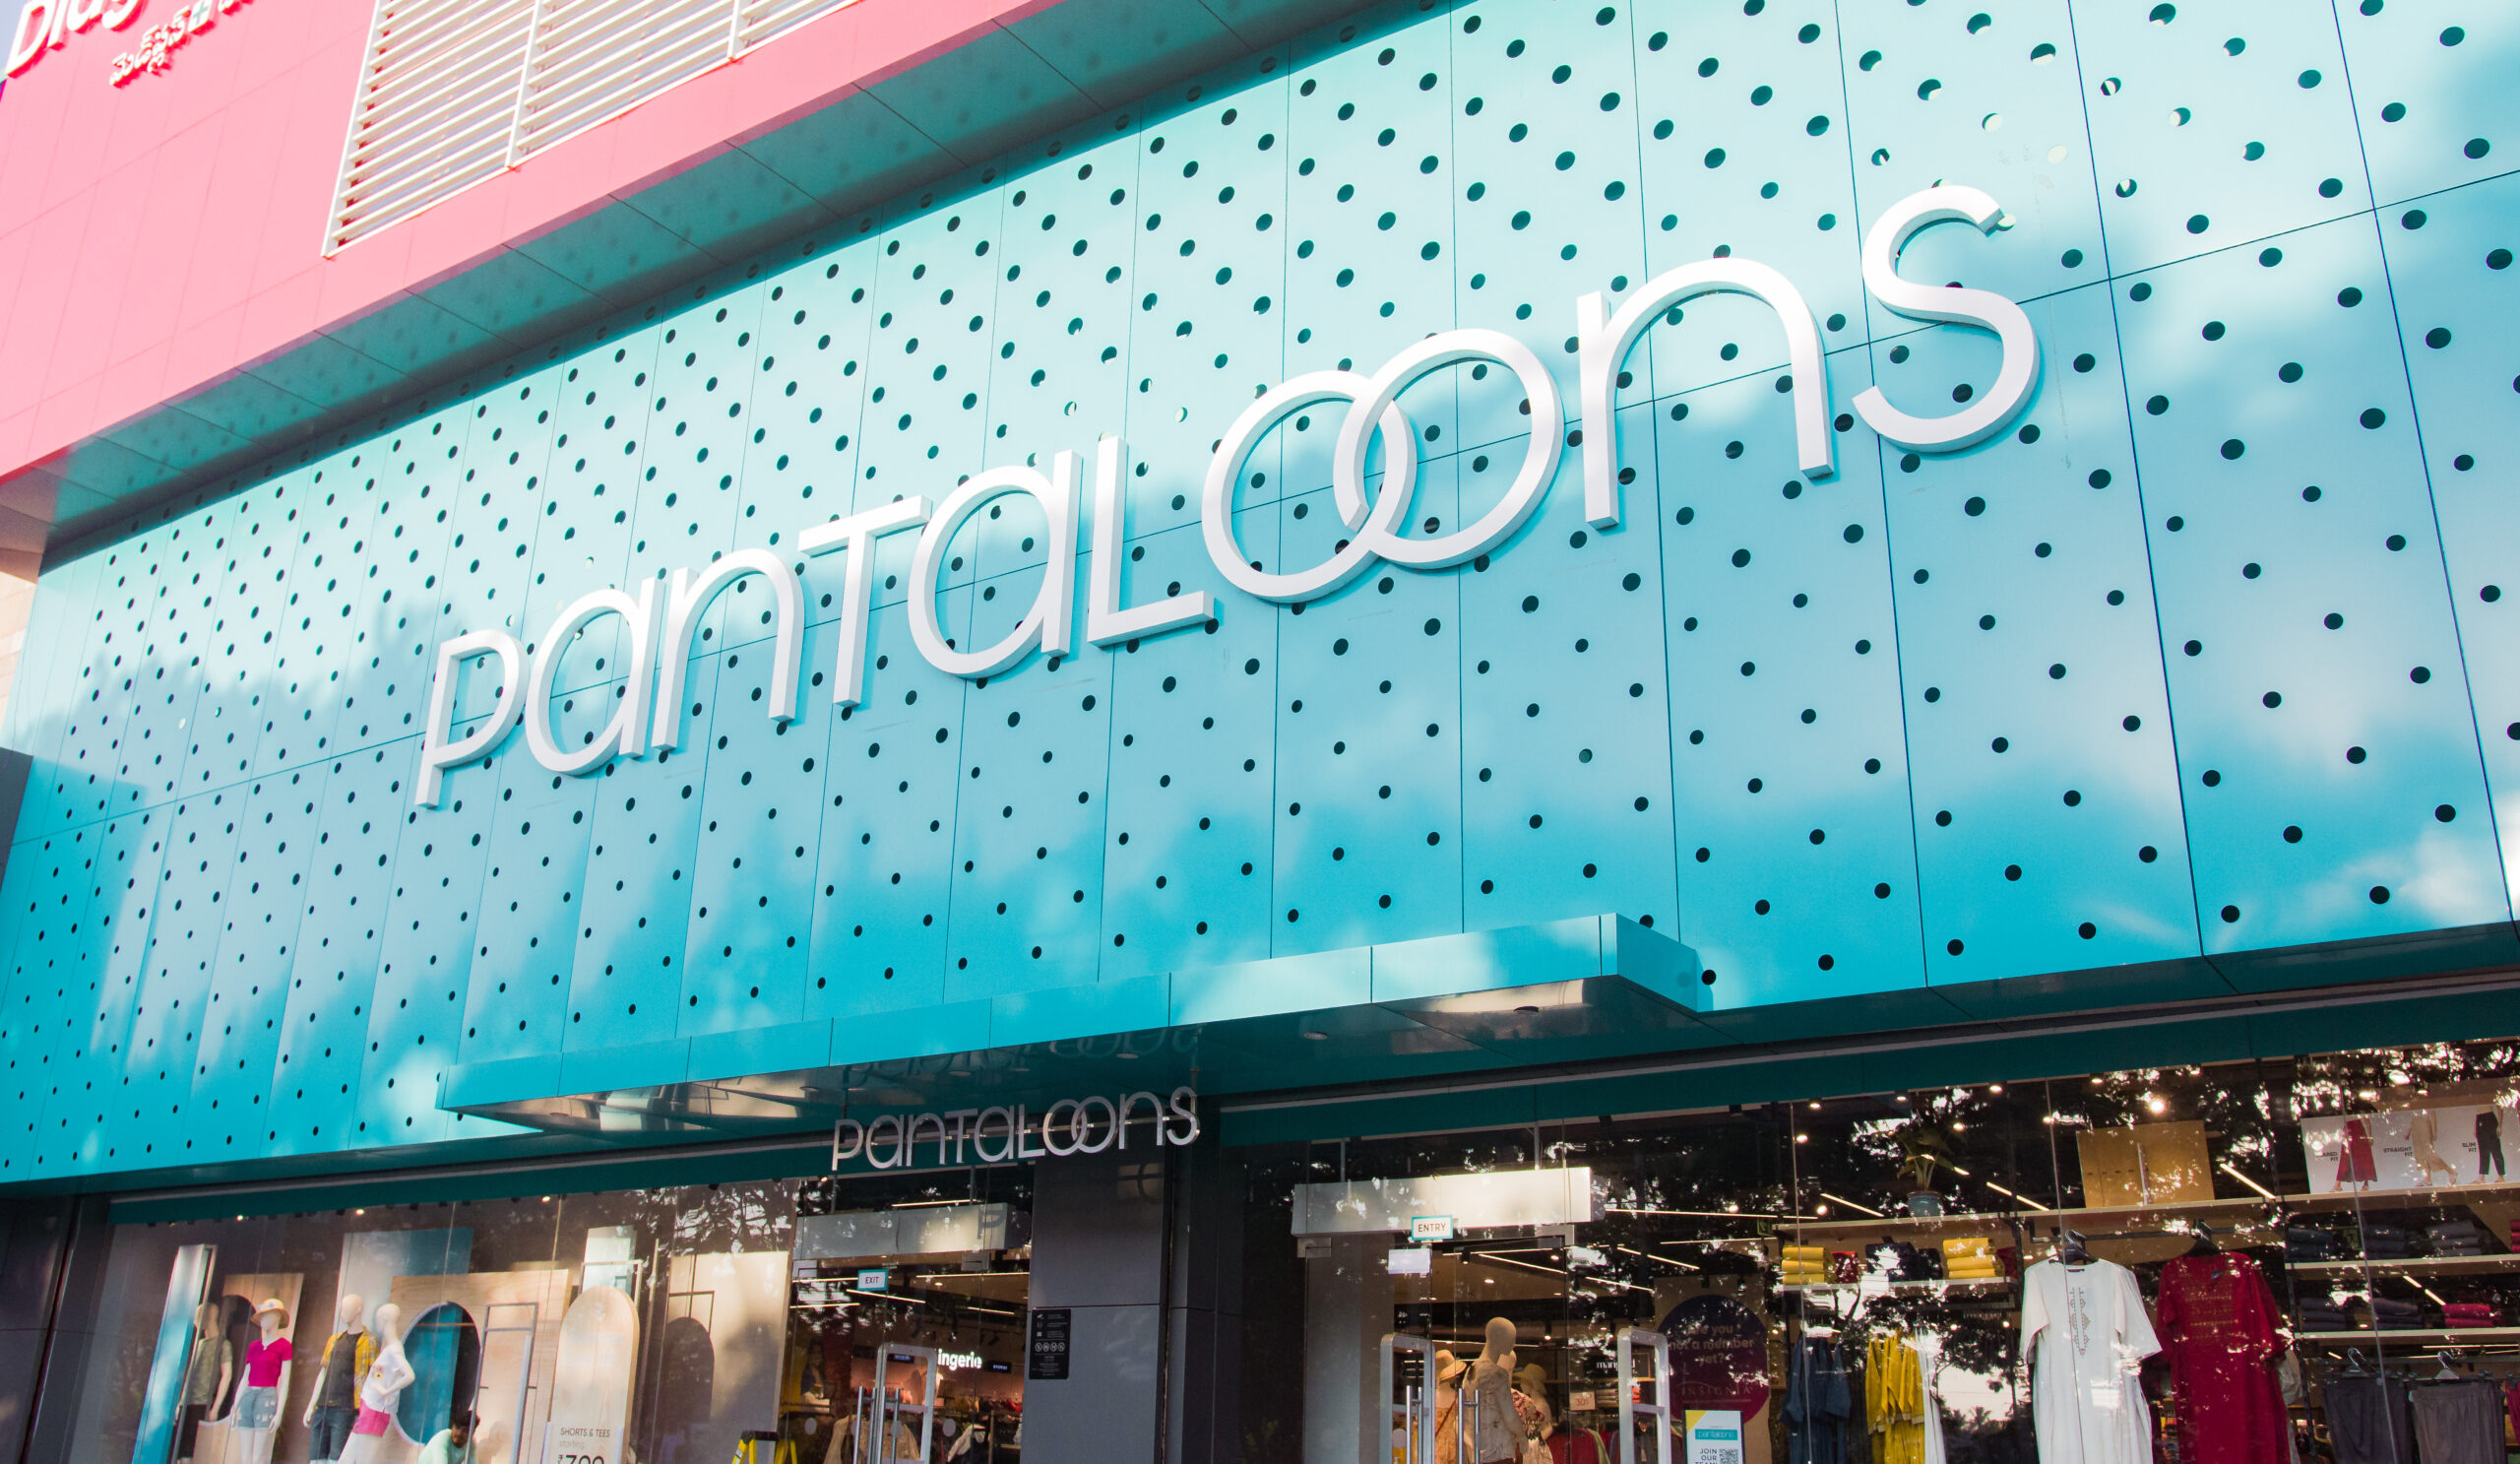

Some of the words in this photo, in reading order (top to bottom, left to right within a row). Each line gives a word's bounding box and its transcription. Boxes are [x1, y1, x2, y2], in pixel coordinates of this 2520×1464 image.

[1418, 1223, 1446, 1233] ENTRY
[1712, 1324, 1732, 1336] you
[1669, 1339, 1688, 1350] not
[1692, 1341, 1700, 1350] a
[1703, 1338, 1753, 1350] member
[937, 1348, 982, 1370] ingerie
[1697, 1352, 1725, 1367] yet?
[560, 1427, 588, 1436] SHORTS
[589, 1429, 594, 1437] &
[596, 1429, 610, 1437] TEES
